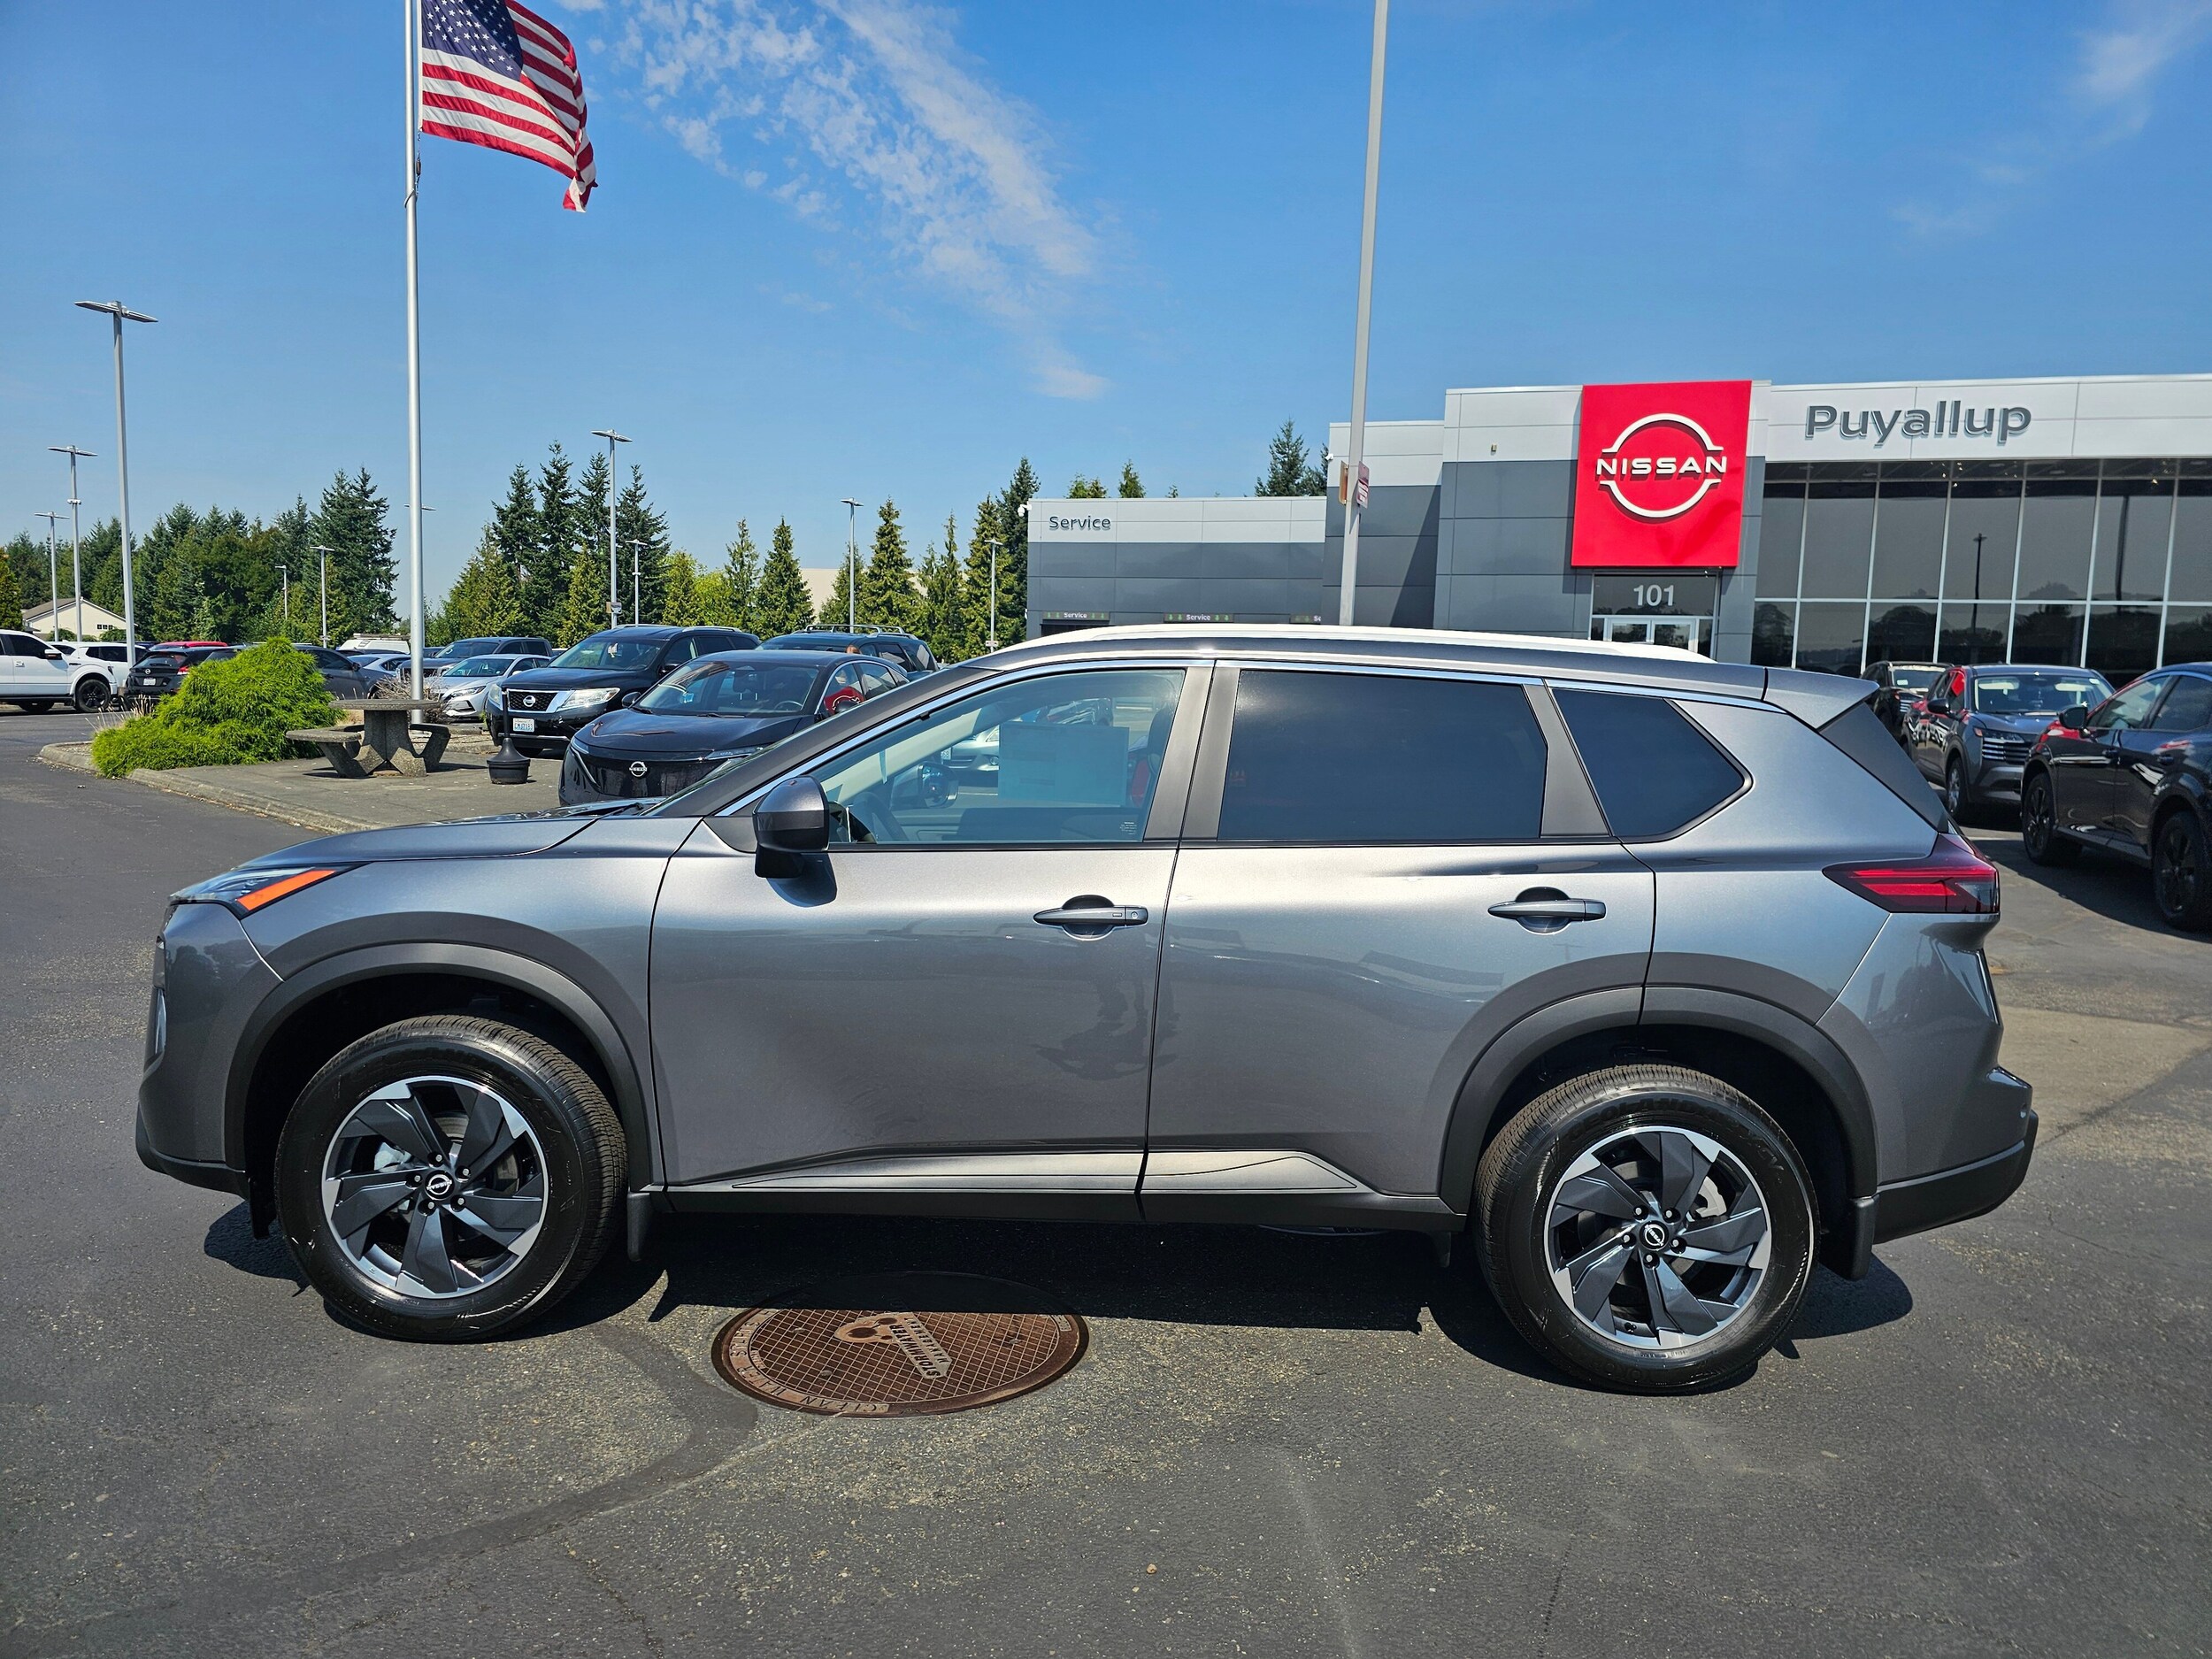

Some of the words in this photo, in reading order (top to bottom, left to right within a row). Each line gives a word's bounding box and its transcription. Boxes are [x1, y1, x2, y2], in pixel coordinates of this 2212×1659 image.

[1805, 399, 2032, 446] Puyallup
[1595, 455, 1727, 476] NISSAN
[1048, 516, 1111, 530] Service
[1633, 584, 1674, 606] 101
[888, 1324, 941, 1377] STORMWATER
